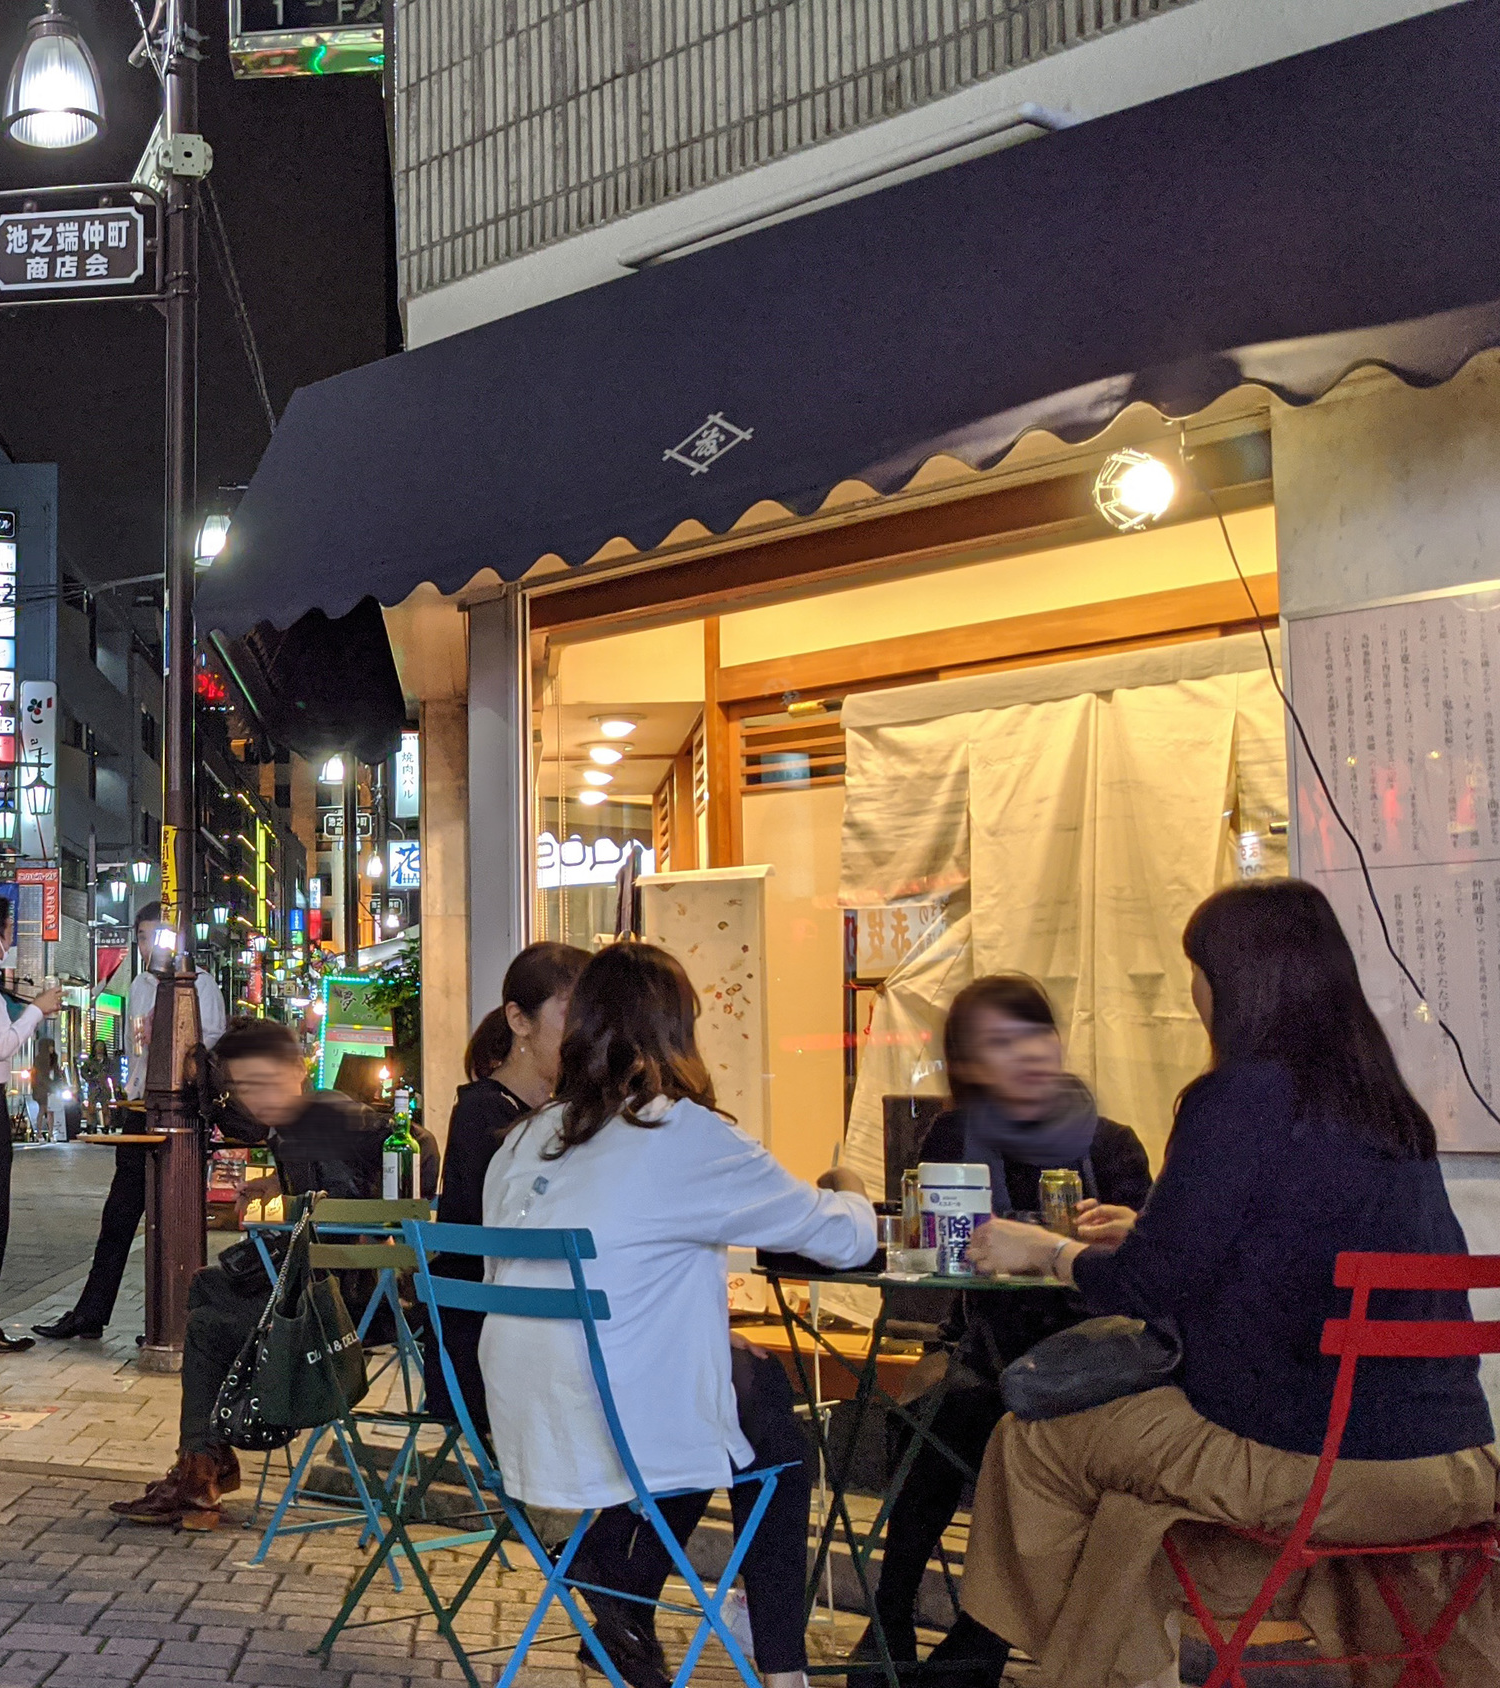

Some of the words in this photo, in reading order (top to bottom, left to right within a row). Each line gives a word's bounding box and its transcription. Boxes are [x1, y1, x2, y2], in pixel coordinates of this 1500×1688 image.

[5, 220, 130, 255] 池之端仲町
[26, 253, 109, 280] 商店会
[401, 751, 415, 799] 焼肉バル
